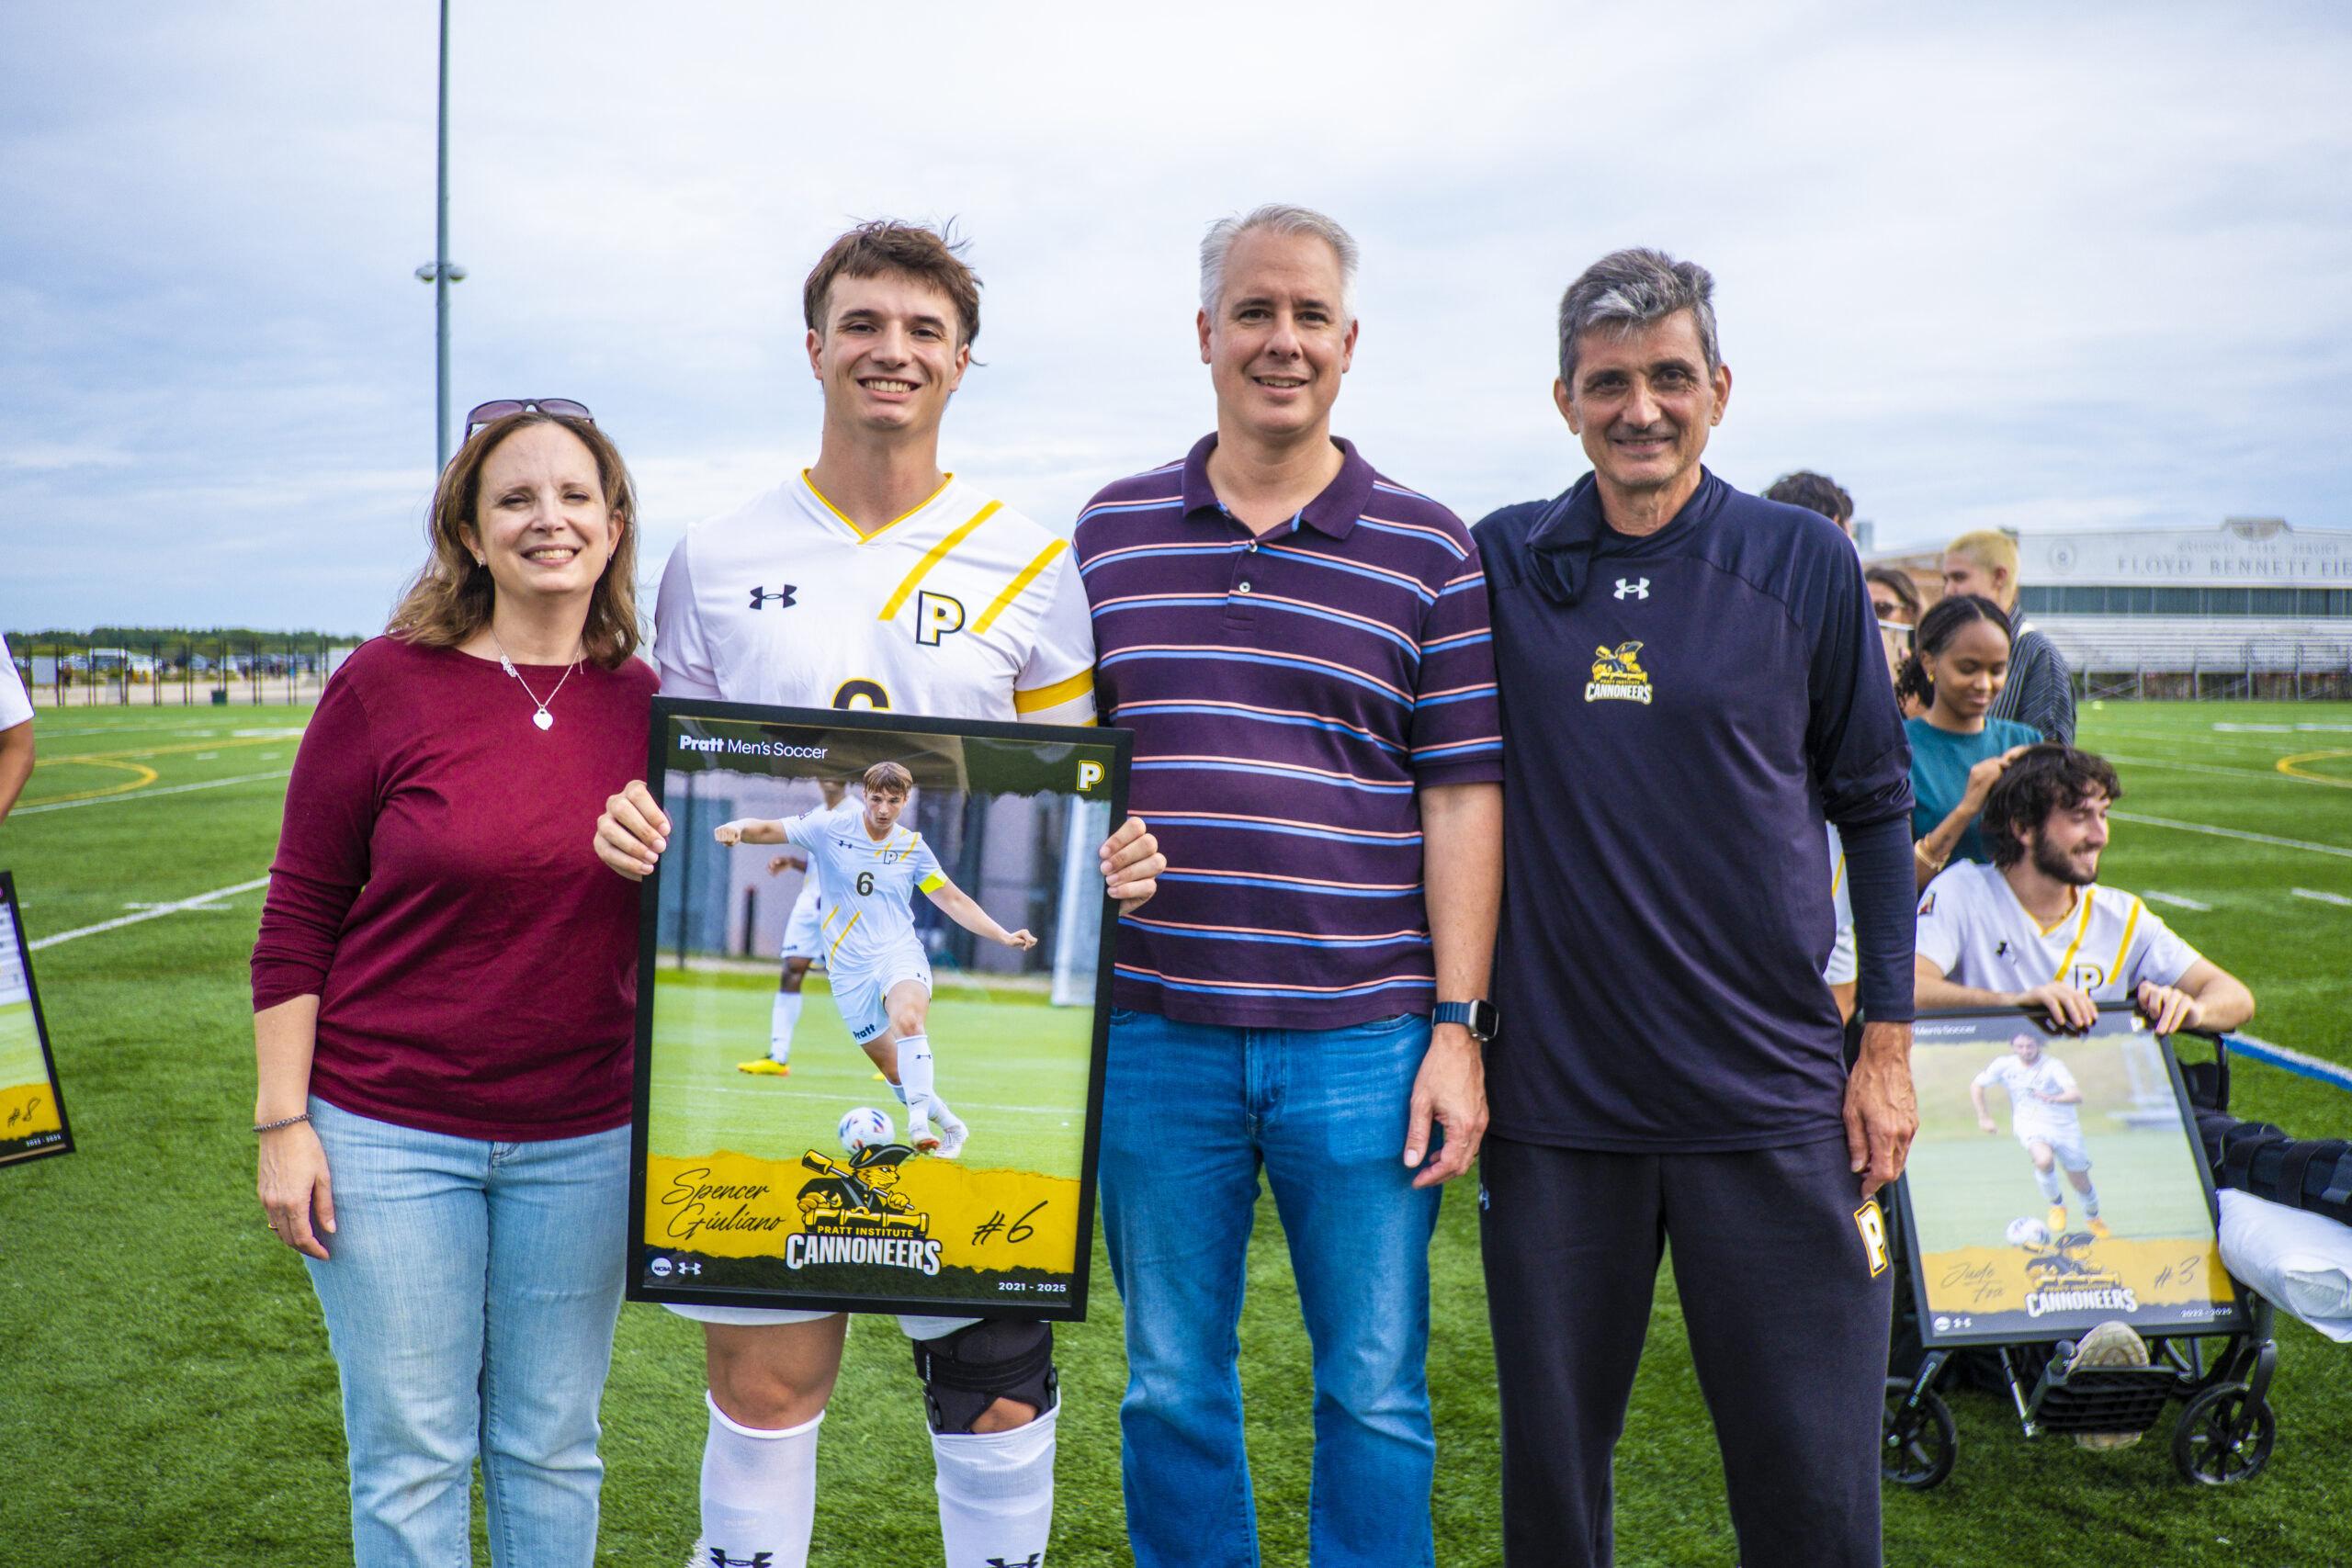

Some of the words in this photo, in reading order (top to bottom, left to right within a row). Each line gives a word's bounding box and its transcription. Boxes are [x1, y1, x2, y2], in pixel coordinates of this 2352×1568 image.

[2118, 556, 2192, 574] FLOYD
[2210, 557, 2309, 576] BENNETT
[916, 590, 966, 647] P
[1585, 682, 1653, 704] CANNONEERS
[678, 734, 724, 752] Pratt
[773, 742, 828, 760] Soccer
[1077, 760, 1105, 791] P
[883, 851, 898, 864] P
[855, 871, 875, 897] 6
[2075, 964, 2104, 997] P
[662, 1168, 770, 1211] Spencer
[667, 1202, 786, 1240] Giuliano
[817, 1225, 853, 1235] PRATT
[855, 1227, 914, 1237] INSTITUTE
[971, 1200, 1048, 1246] #6
[1854, 1201, 1888, 1278] P
[786, 1234, 942, 1276] CANNONEERS
[998, 1282, 1026, 1292] 2021
[1036, 1283, 1067, 1292] 2025
[2025, 1288, 2139, 1318] CANNONEERS
